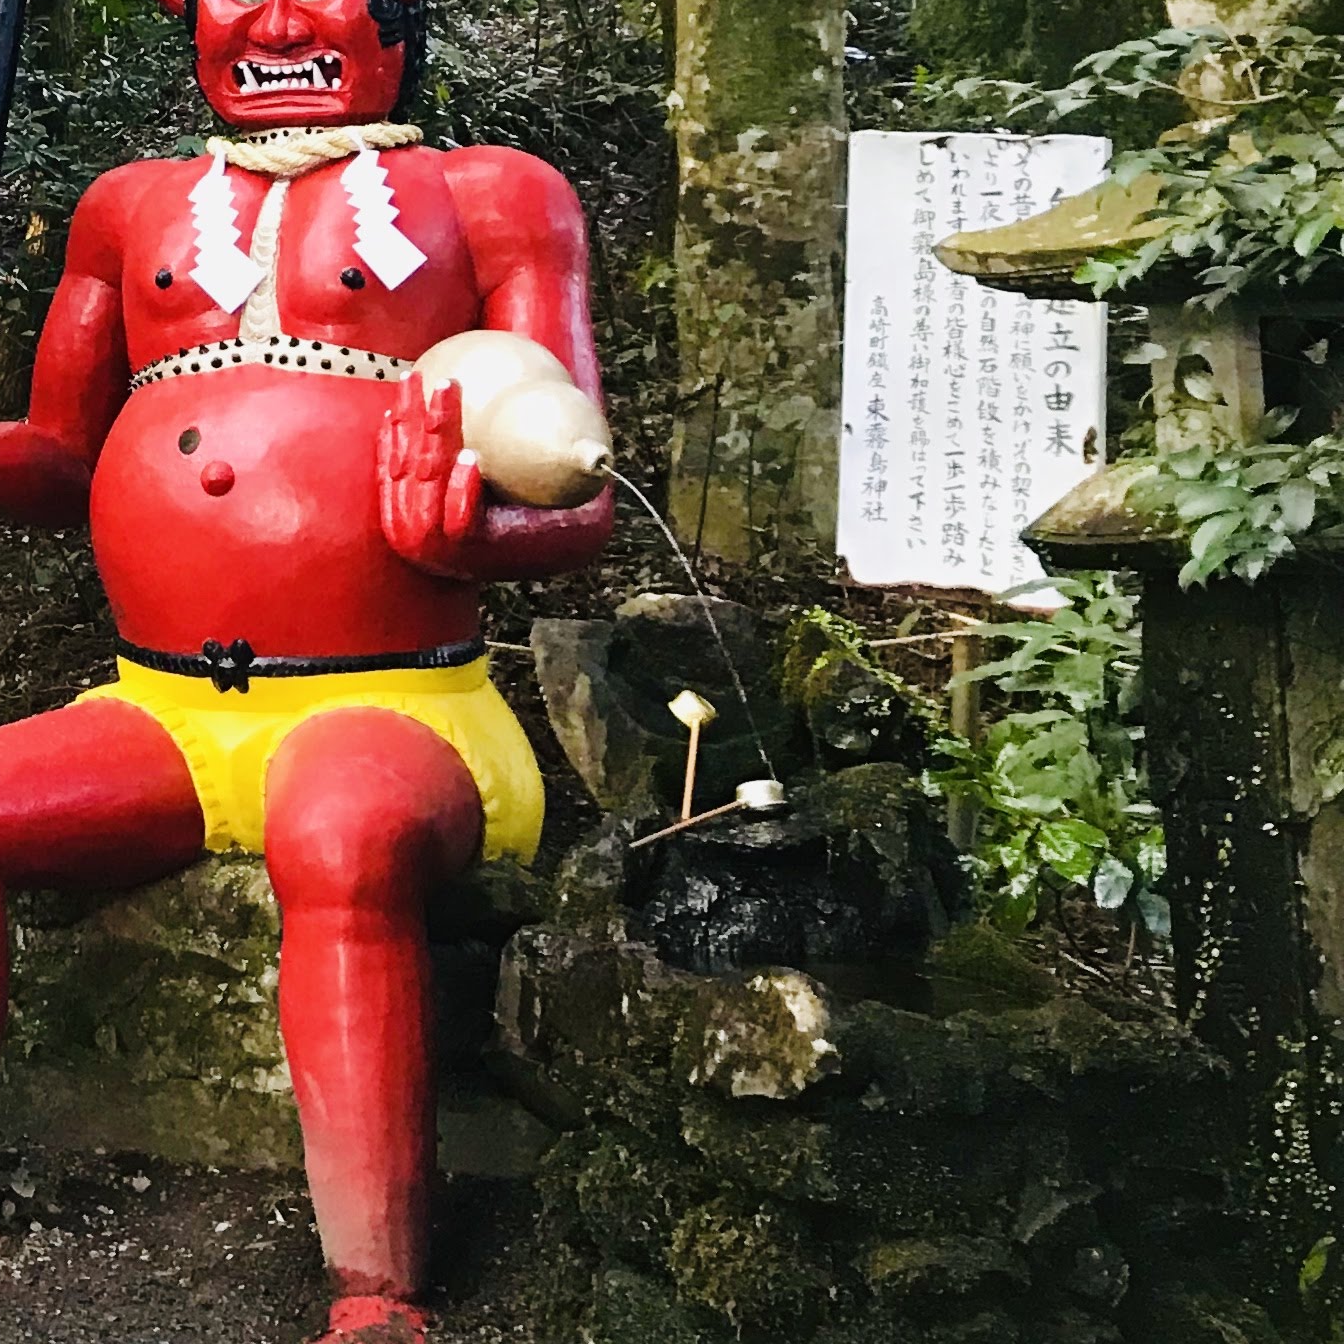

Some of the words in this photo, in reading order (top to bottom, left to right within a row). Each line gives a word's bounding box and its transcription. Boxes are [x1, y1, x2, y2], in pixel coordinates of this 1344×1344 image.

[941, 273, 970, 567] 者の皆様心をこめて一歩一歩踏み
